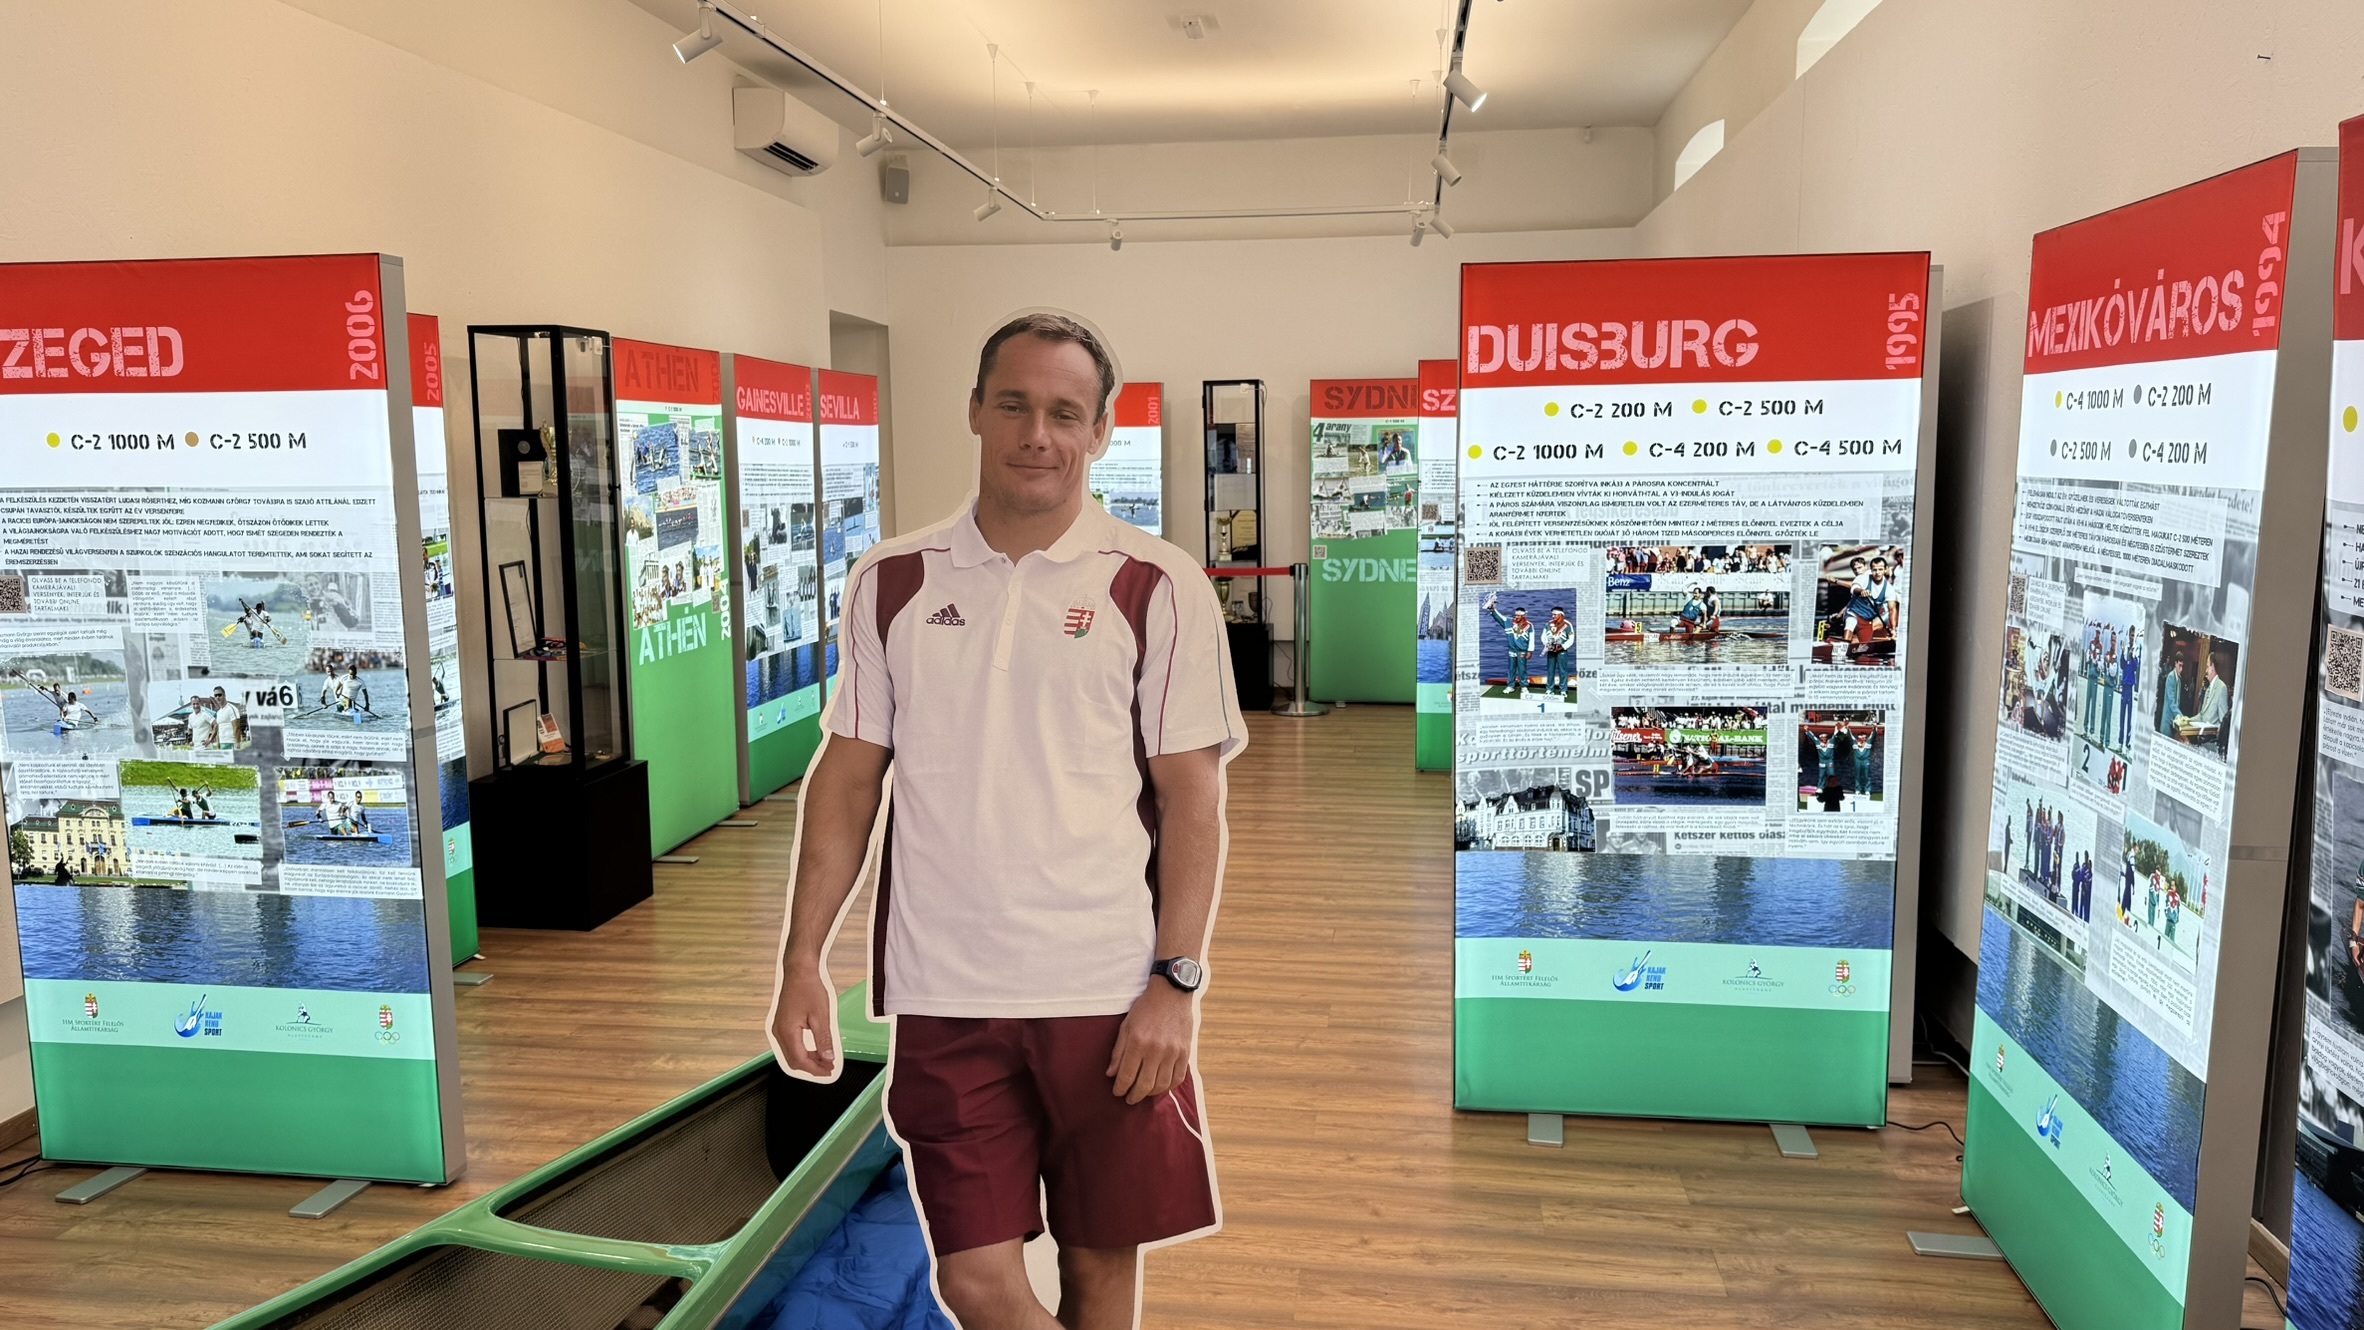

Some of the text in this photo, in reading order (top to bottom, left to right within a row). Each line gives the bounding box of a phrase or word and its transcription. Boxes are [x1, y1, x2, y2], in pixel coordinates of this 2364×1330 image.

[2253, 210, 2286, 337] 1994
[2027, 269, 2245, 358] MEXIKÓVÁROS
[344, 289, 379, 381] 2006
[1884, 292, 1921, 370] 1995
[0, 326, 184, 379] ZEGED
[1467, 318, 1759, 374] DUISBURG
[425, 342, 441, 402] 2005
[624, 347, 700, 392] ATHÉN
[736, 386, 804, 417] GAINESVILLE
[820, 394, 860, 420] SEVILLA
[1422, 389, 1456, 411] SZ
[1570, 399, 1824, 419] C-2 200 M C-2 500 M
[2066, 382, 2212, 410] C-4 1000 M C-2 200 M
[1148, 397, 1158, 424] 2001
[70, 432, 307, 450] C-2 1000 M C-2 500 M
[1313, 423, 1352, 442] 4 arany
[1493, 439, 1902, 461] C-2 1000 M C-4 200 M C-4 500 M
[2061, 442, 2207, 464] C-2 500 M C-4 200 M
[1564, 480, 1598, 488] SZORÍTVA
[1322, 558, 1416, 582] SYDNE
[1608, 576, 1630, 587] Benz
[2354, 579, 2360, 588] 21
[720, 578, 730, 641] 2004
[926, 617, 966, 626] adidas
[638, 607, 707, 666] ATHÉN
[280, 686, 293, 706] 6
[1537, 703, 1545, 713] 1
[2082, 744, 2090, 773] 2
[1575, 770, 1610, 798] SP
[1850, 801, 1856, 812] 1
